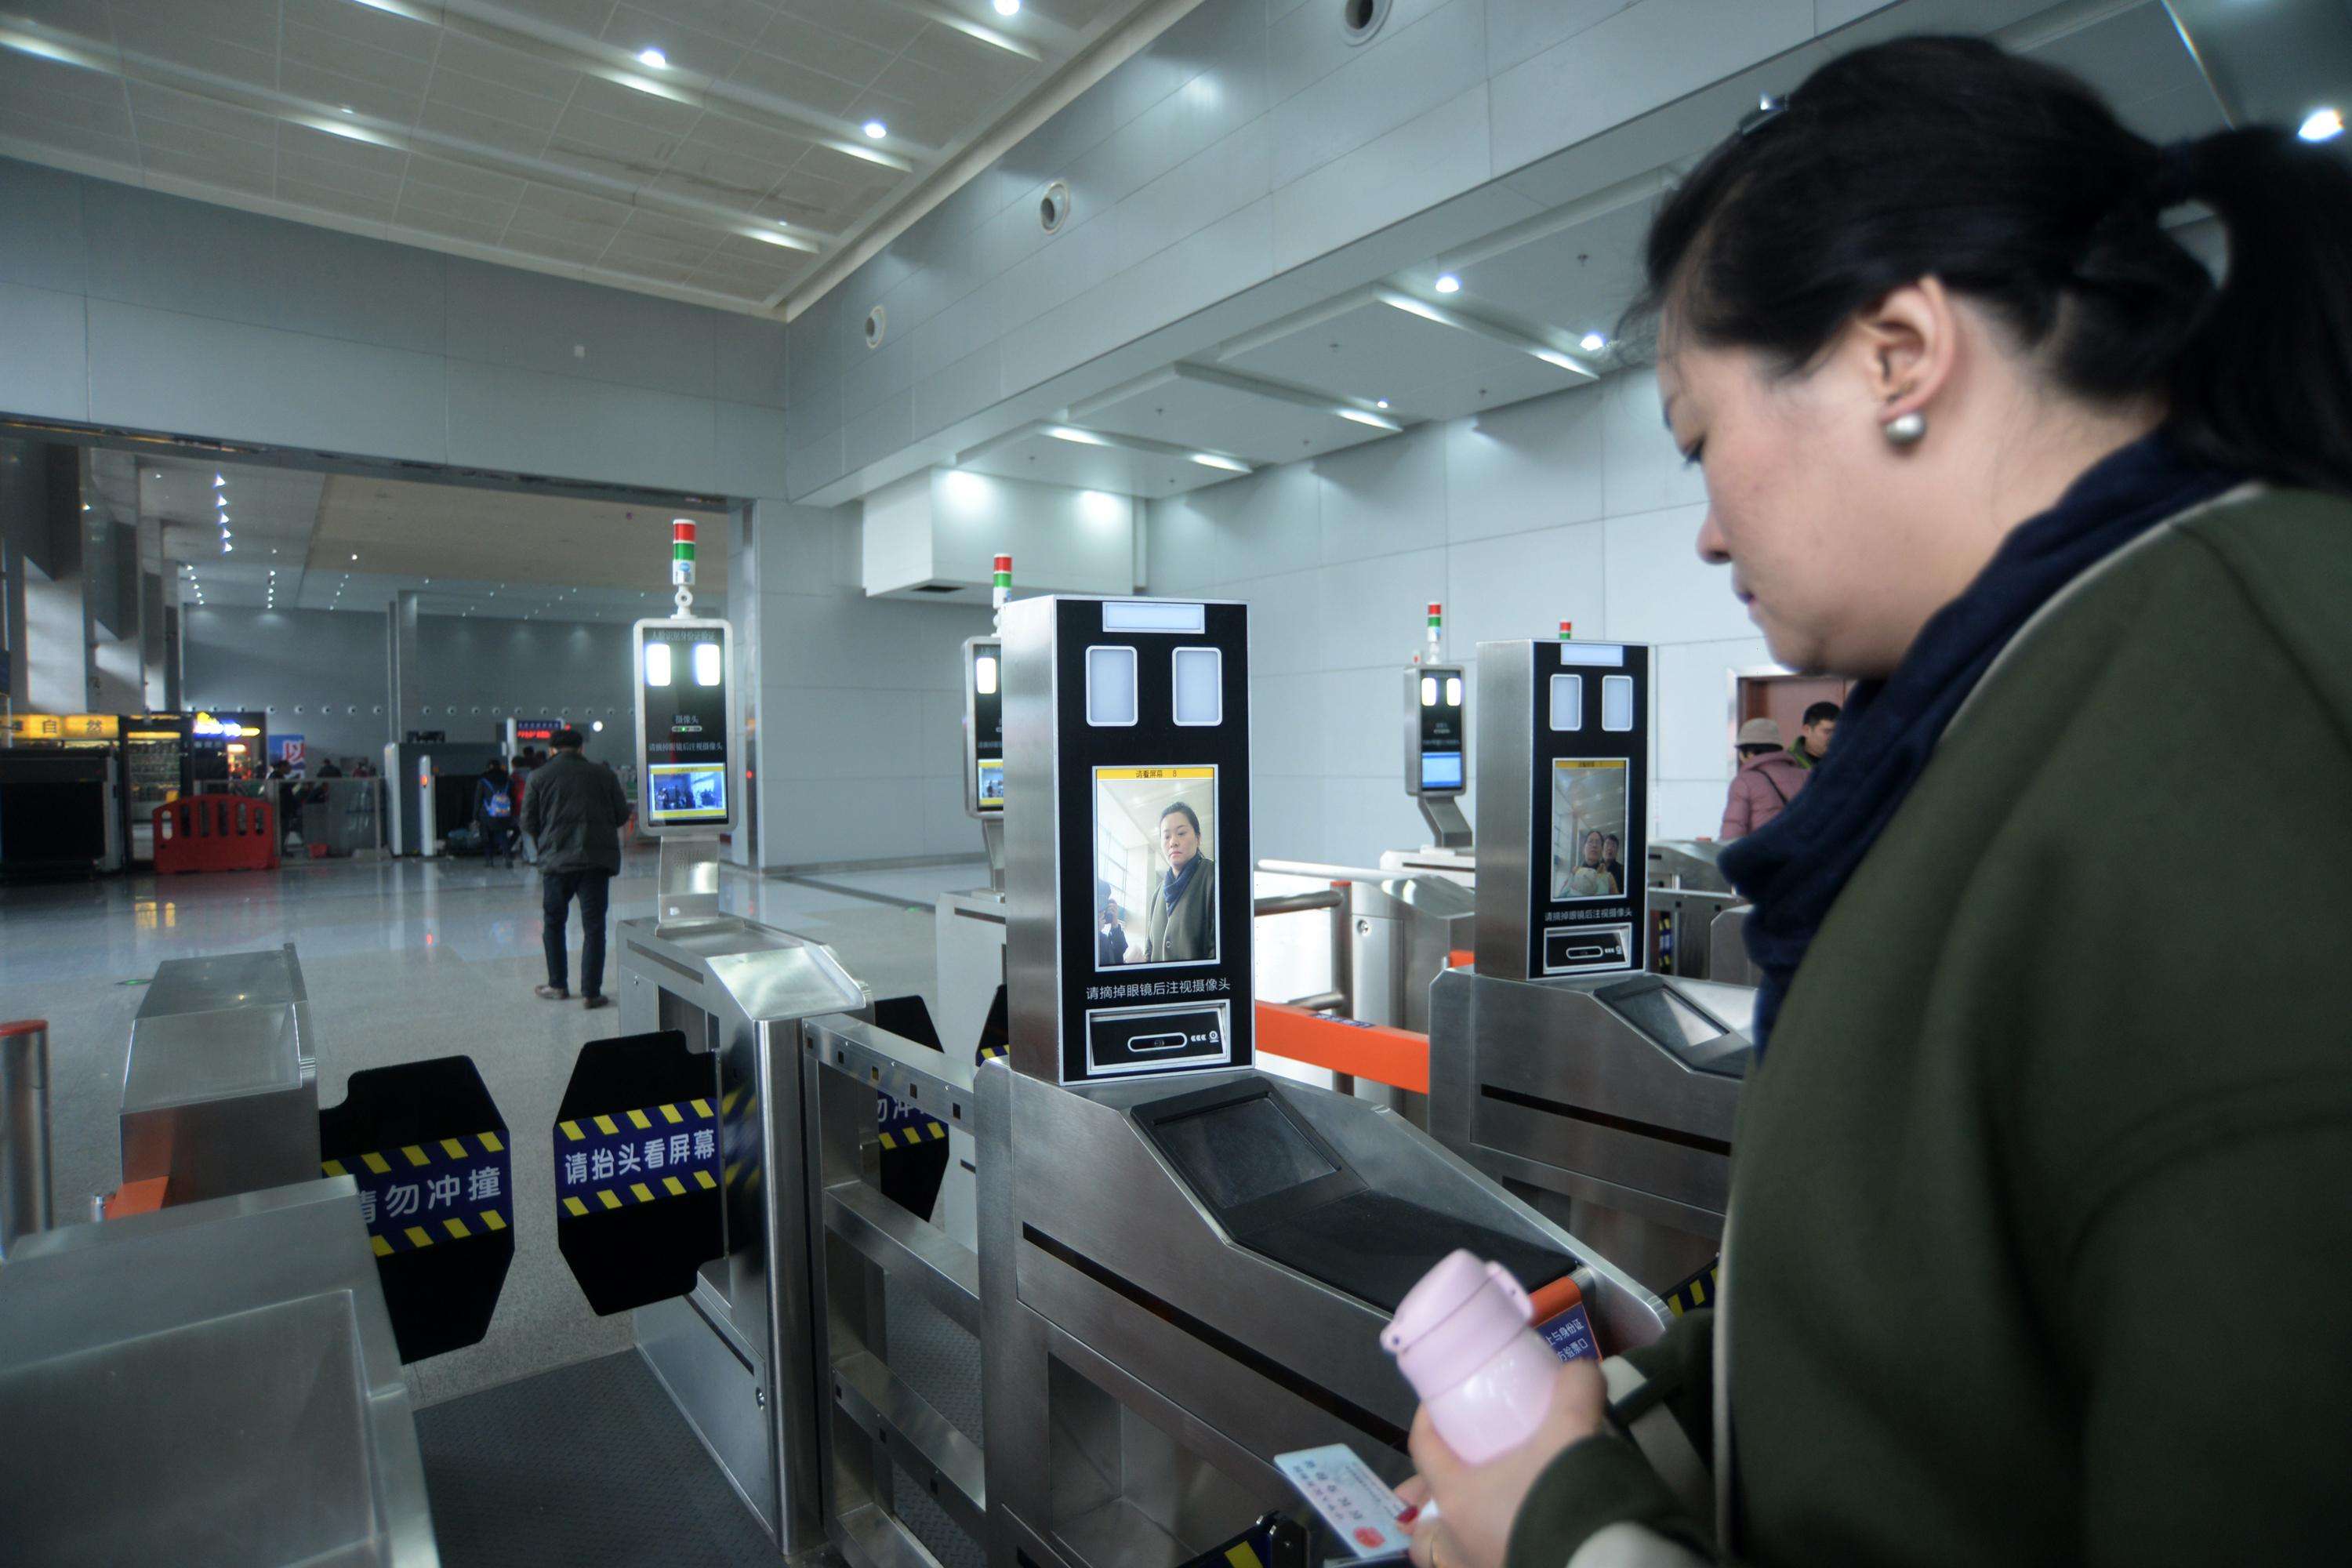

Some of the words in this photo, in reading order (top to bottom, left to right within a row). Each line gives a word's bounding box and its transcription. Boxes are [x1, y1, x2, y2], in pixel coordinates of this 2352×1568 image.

[1086, 977, 1231, 1000] 请摘掉眼镜后注视摄像头
[565, 1128, 715, 1185] 请抬头看屏幕
